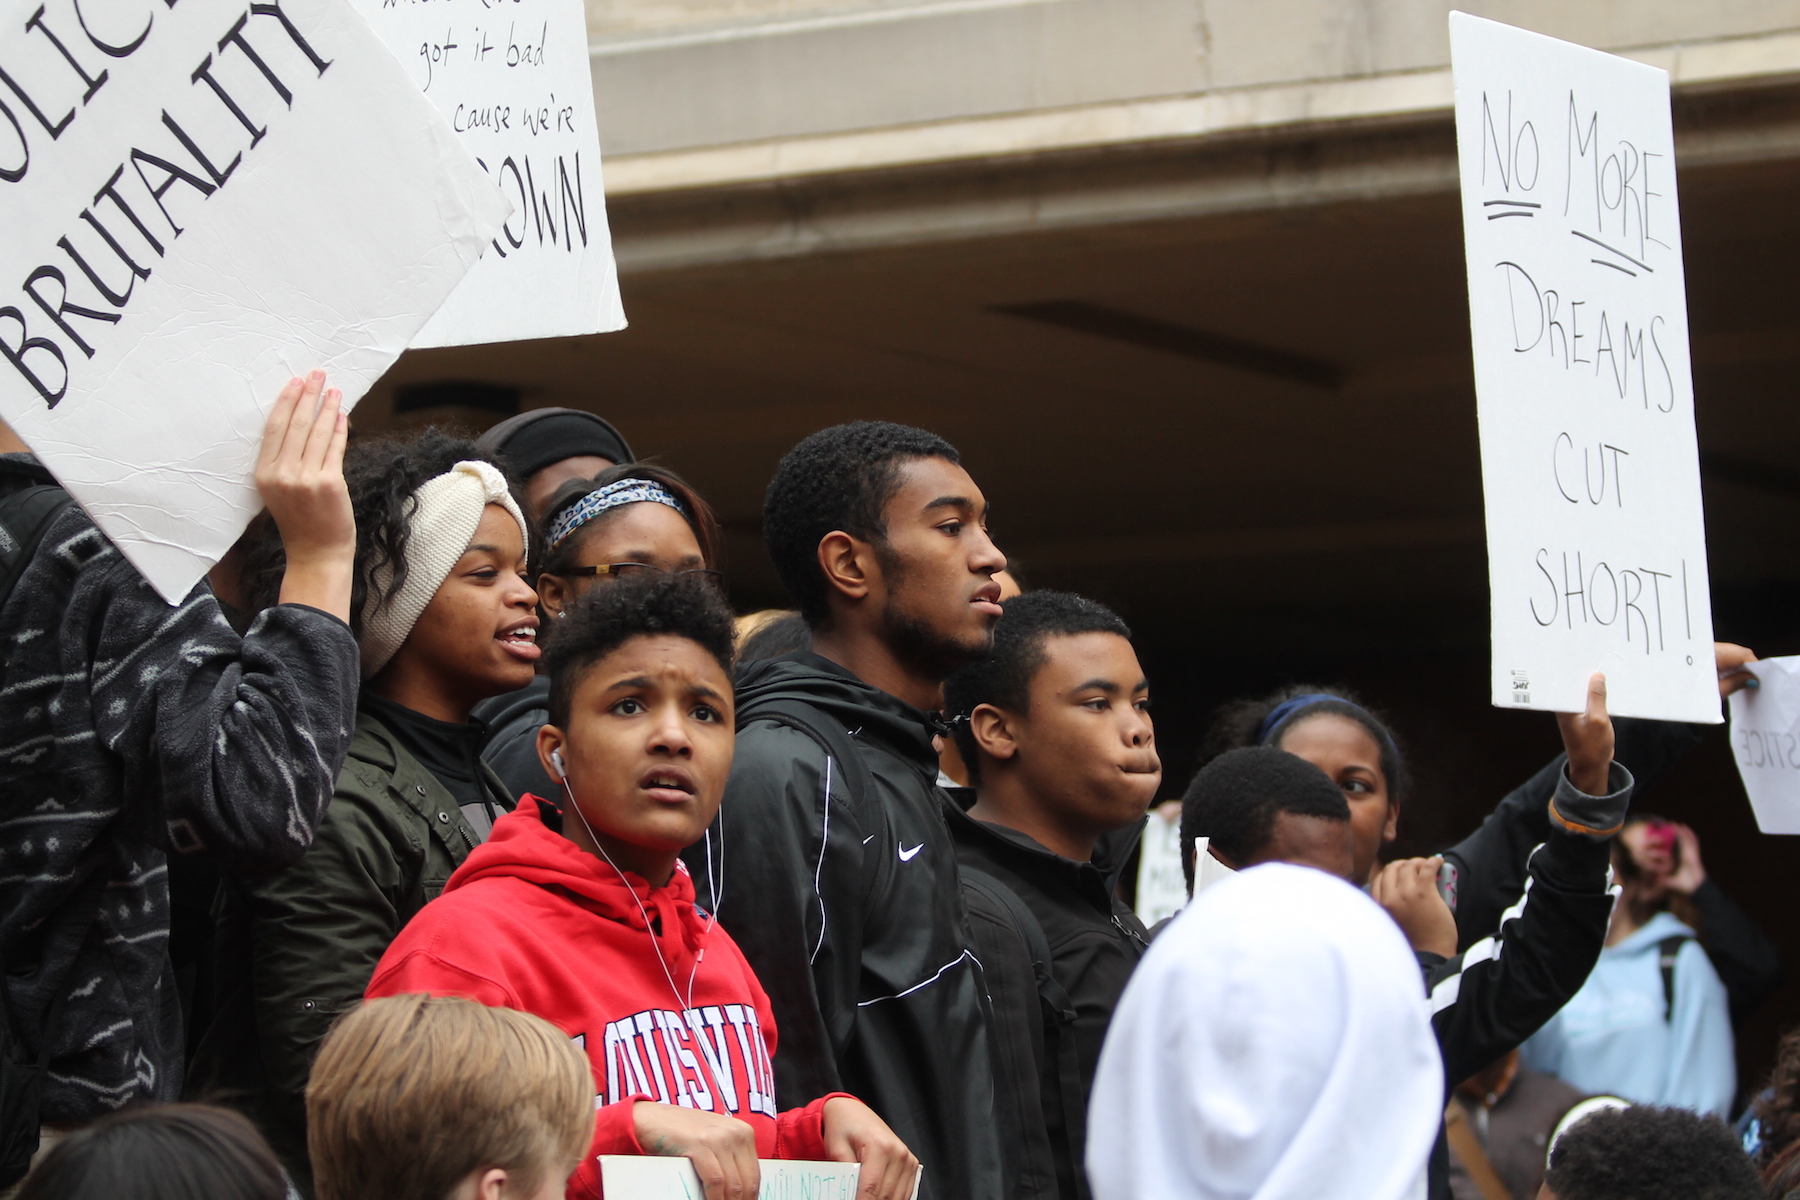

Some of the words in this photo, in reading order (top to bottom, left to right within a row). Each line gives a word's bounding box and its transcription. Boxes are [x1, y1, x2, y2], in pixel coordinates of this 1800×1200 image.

[420, 27, 458, 92] got
[474, 27, 494, 62] it
[507, 20, 547, 67] bad
[523, 92, 574, 136] we're
[0, 0, 335, 409] BRUTALITY
[1482, 89, 1539, 193] NO
[1564, 88, 1672, 261] MORE
[1495, 261, 1675, 413] DREAMS
[1554, 432, 1629, 508] CUT
[1530, 548, 1693, 666] SHORT!
